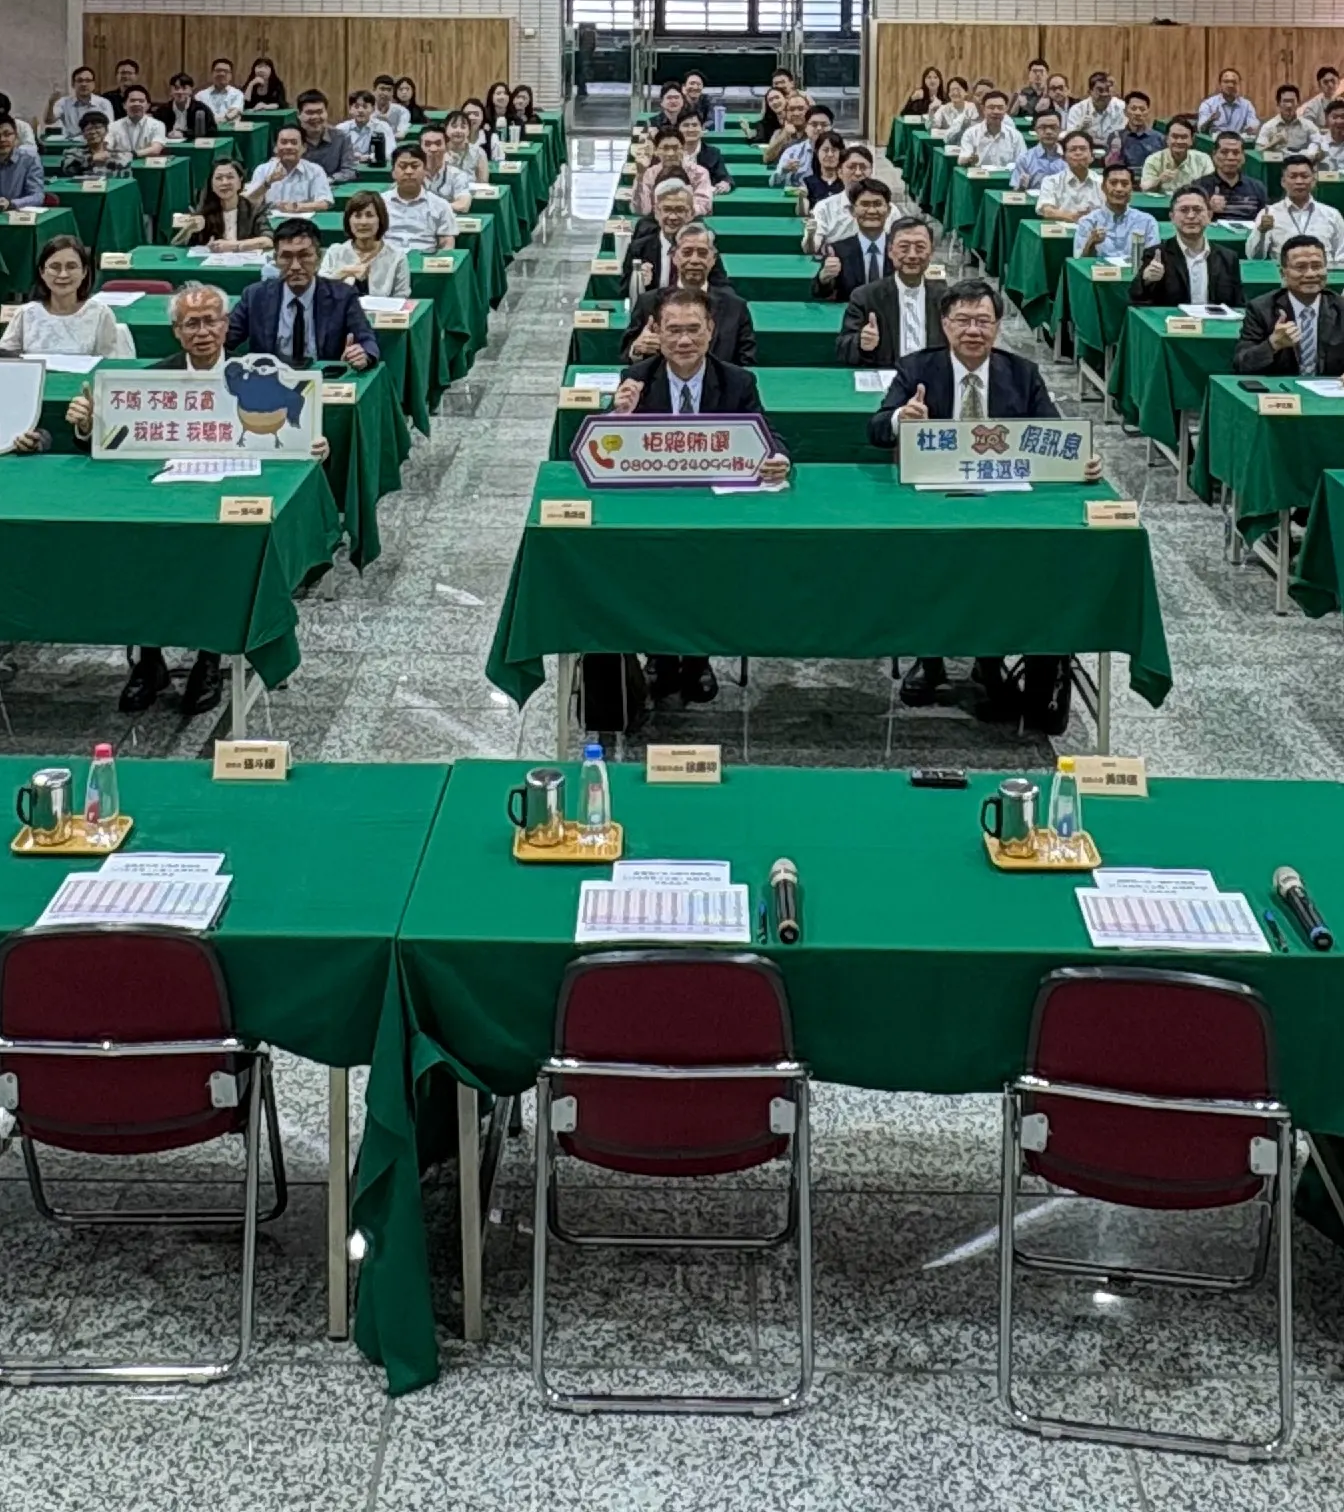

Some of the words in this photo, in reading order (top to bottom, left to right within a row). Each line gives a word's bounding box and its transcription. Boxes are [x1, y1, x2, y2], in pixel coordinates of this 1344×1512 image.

[642, 430, 730, 453] 拒絕賄選
[917, 428, 958, 451] 杜絕
[1019, 425, 1083, 461] 假訊息
